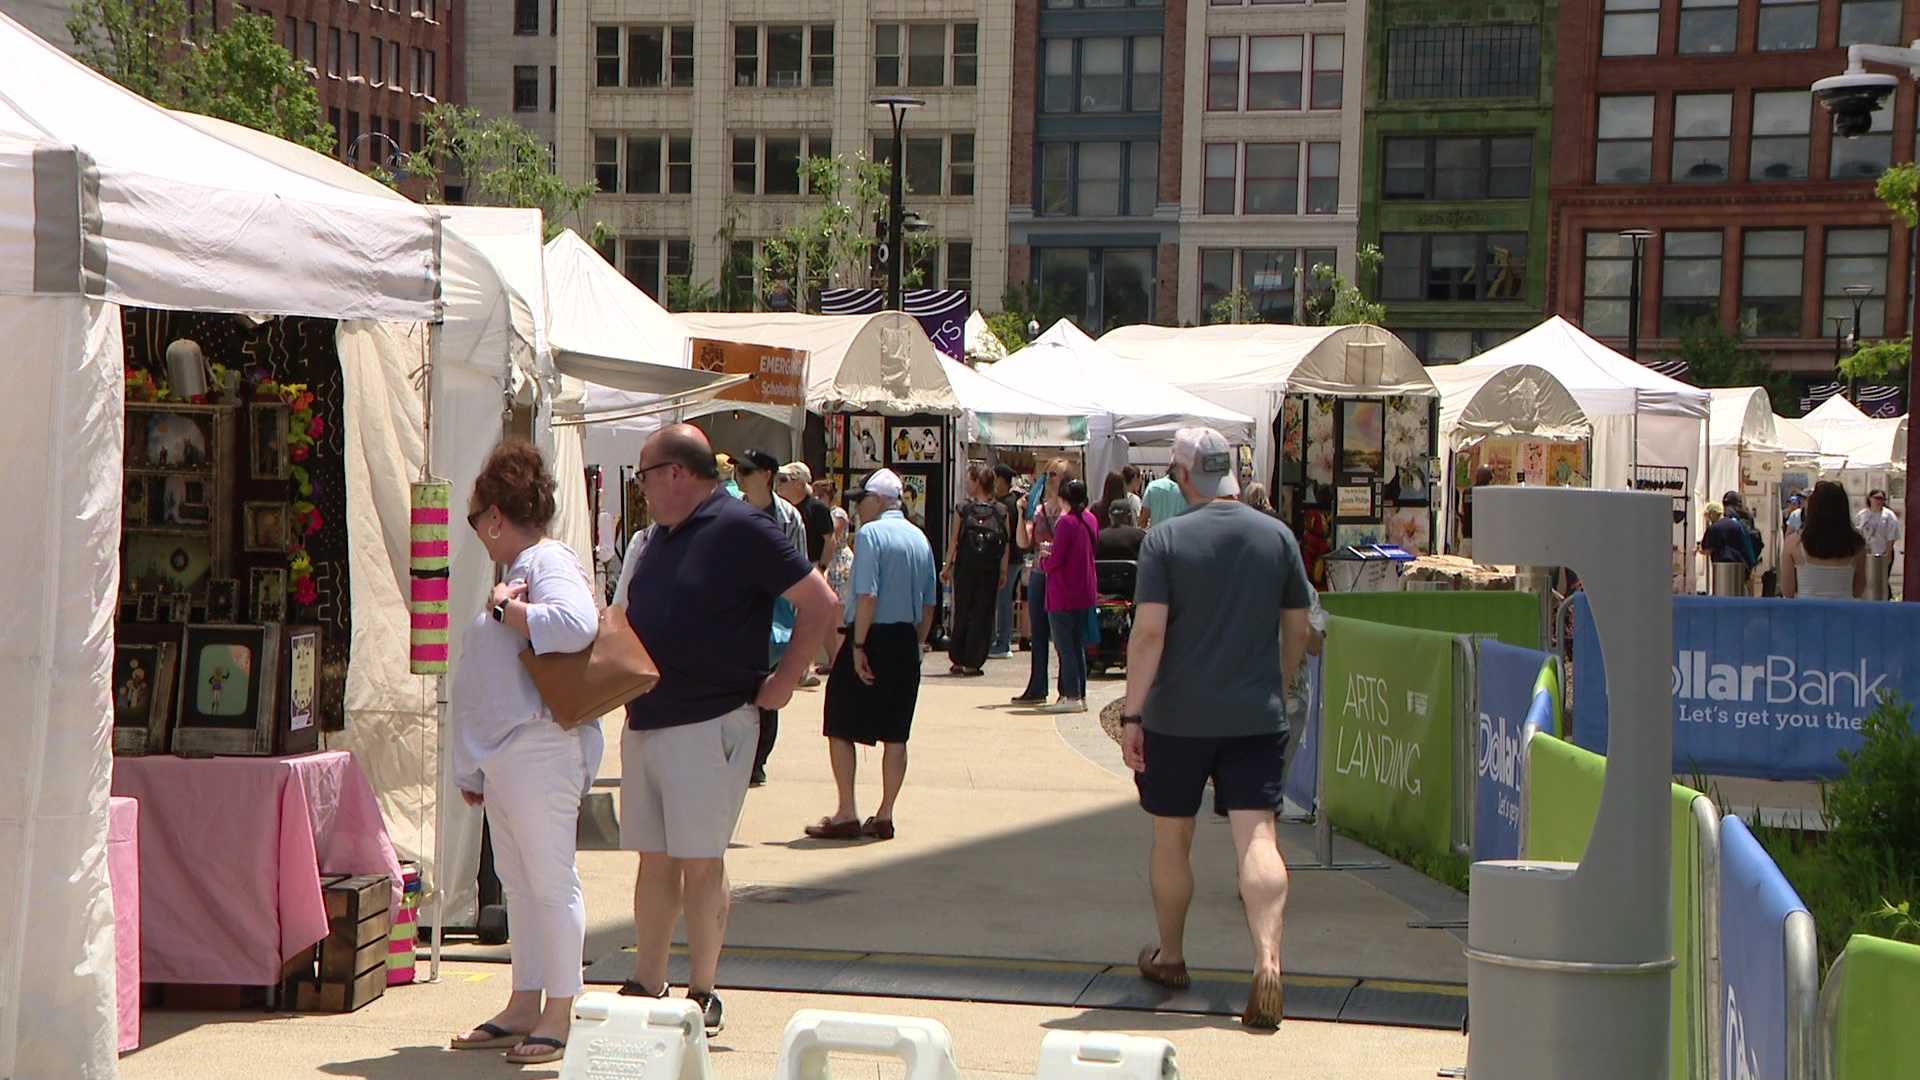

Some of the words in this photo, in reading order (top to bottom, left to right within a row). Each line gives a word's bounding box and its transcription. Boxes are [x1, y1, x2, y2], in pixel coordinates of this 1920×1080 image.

[930, 319, 961, 349] TS
[1342, 671, 1390, 726] ARTS
[1672, 650, 1888, 707] llarBank
[1679, 704, 1729, 723] Let's
[1734, 708, 1770, 727] get
[1774, 712, 1820, 731] you
[1336, 725, 1421, 796] LANDING
